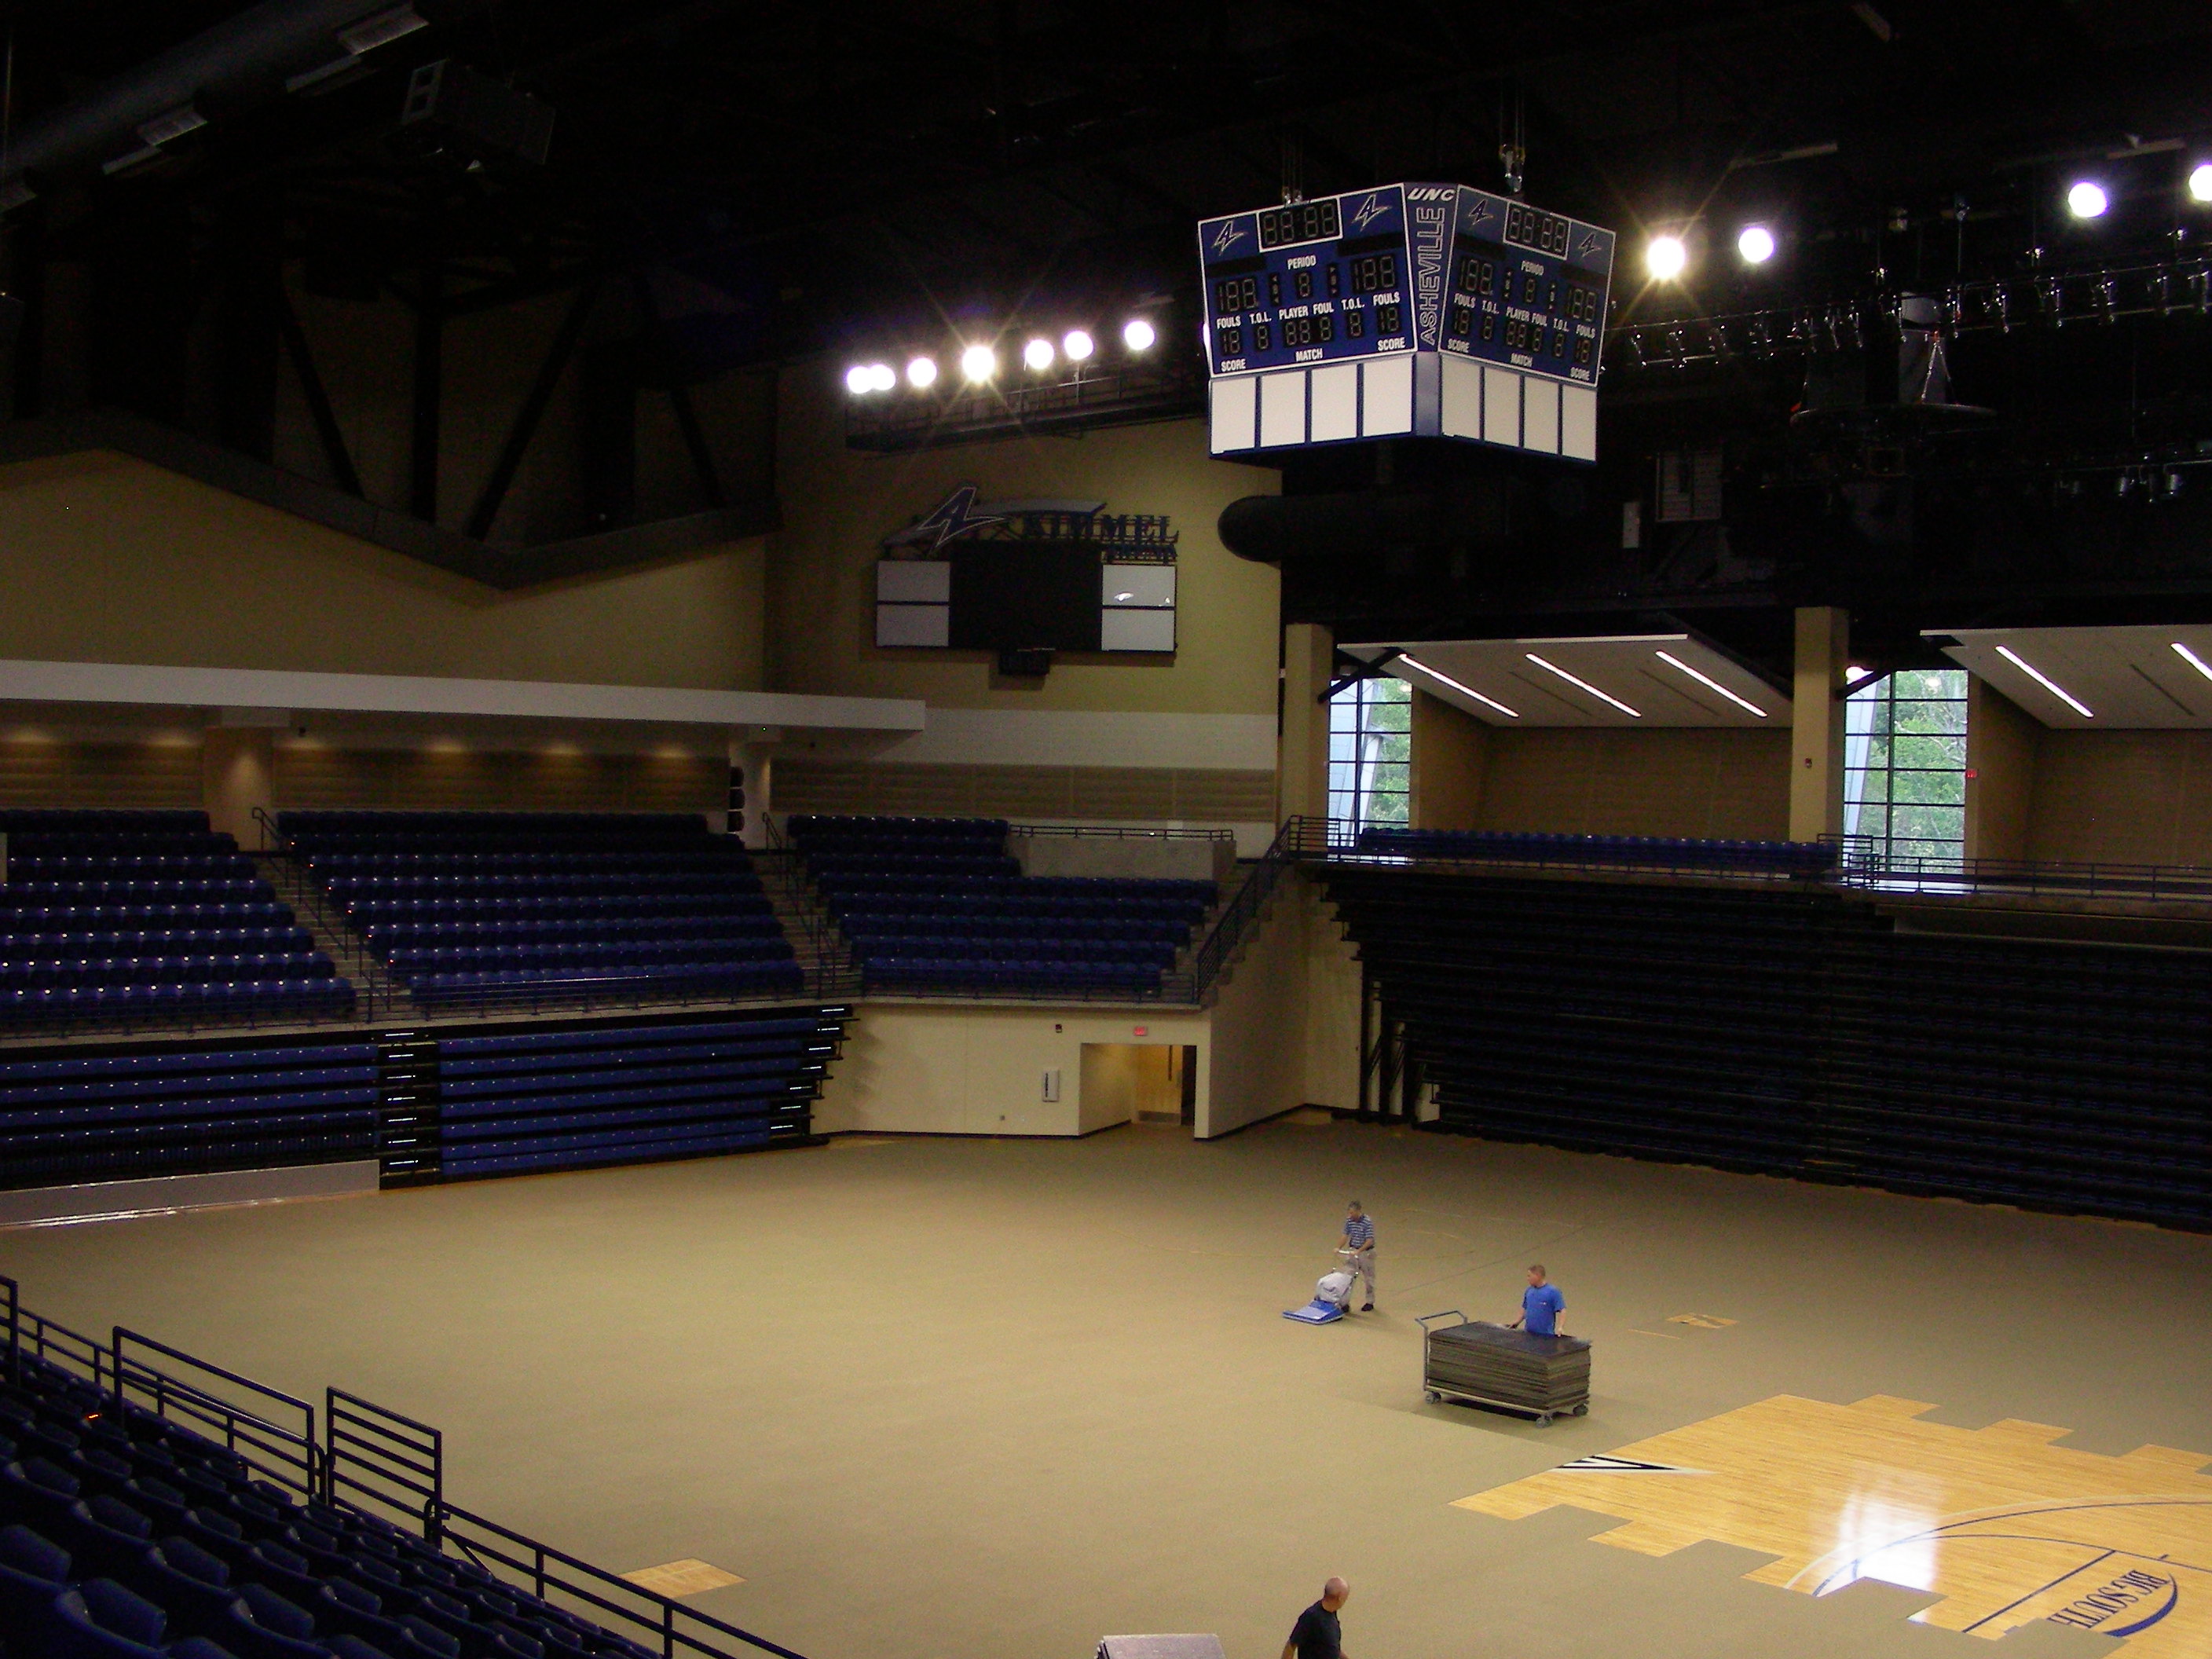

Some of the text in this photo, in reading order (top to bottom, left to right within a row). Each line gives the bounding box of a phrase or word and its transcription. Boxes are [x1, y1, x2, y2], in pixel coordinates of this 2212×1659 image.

[1406, 187, 1456, 203] UNC
[1287, 255, 1317, 270] PERIOD
[1521, 260, 1544, 276] PERIOD
[1416, 206, 1445, 346] ASHEVILLE
[1217, 292, 1400, 328] FOULS T.O.L. PLAYER FOUL T.O.L. FOULS
[1454, 292, 1595, 339] FOULS T.O.L. PLAYER FOUL T.O.L. FOULS
[1378, 337, 1405, 351] SCORE
[1448, 339, 1470, 353] SCORE
[1295, 349, 1323, 361] MATCH
[1511, 353, 1533, 368] MATCH
[1221, 358, 1246, 371] SCORE
[1571, 367, 1590, 381] SCORE
[2046, 1569, 2170, 1628] BIG SOUTH
